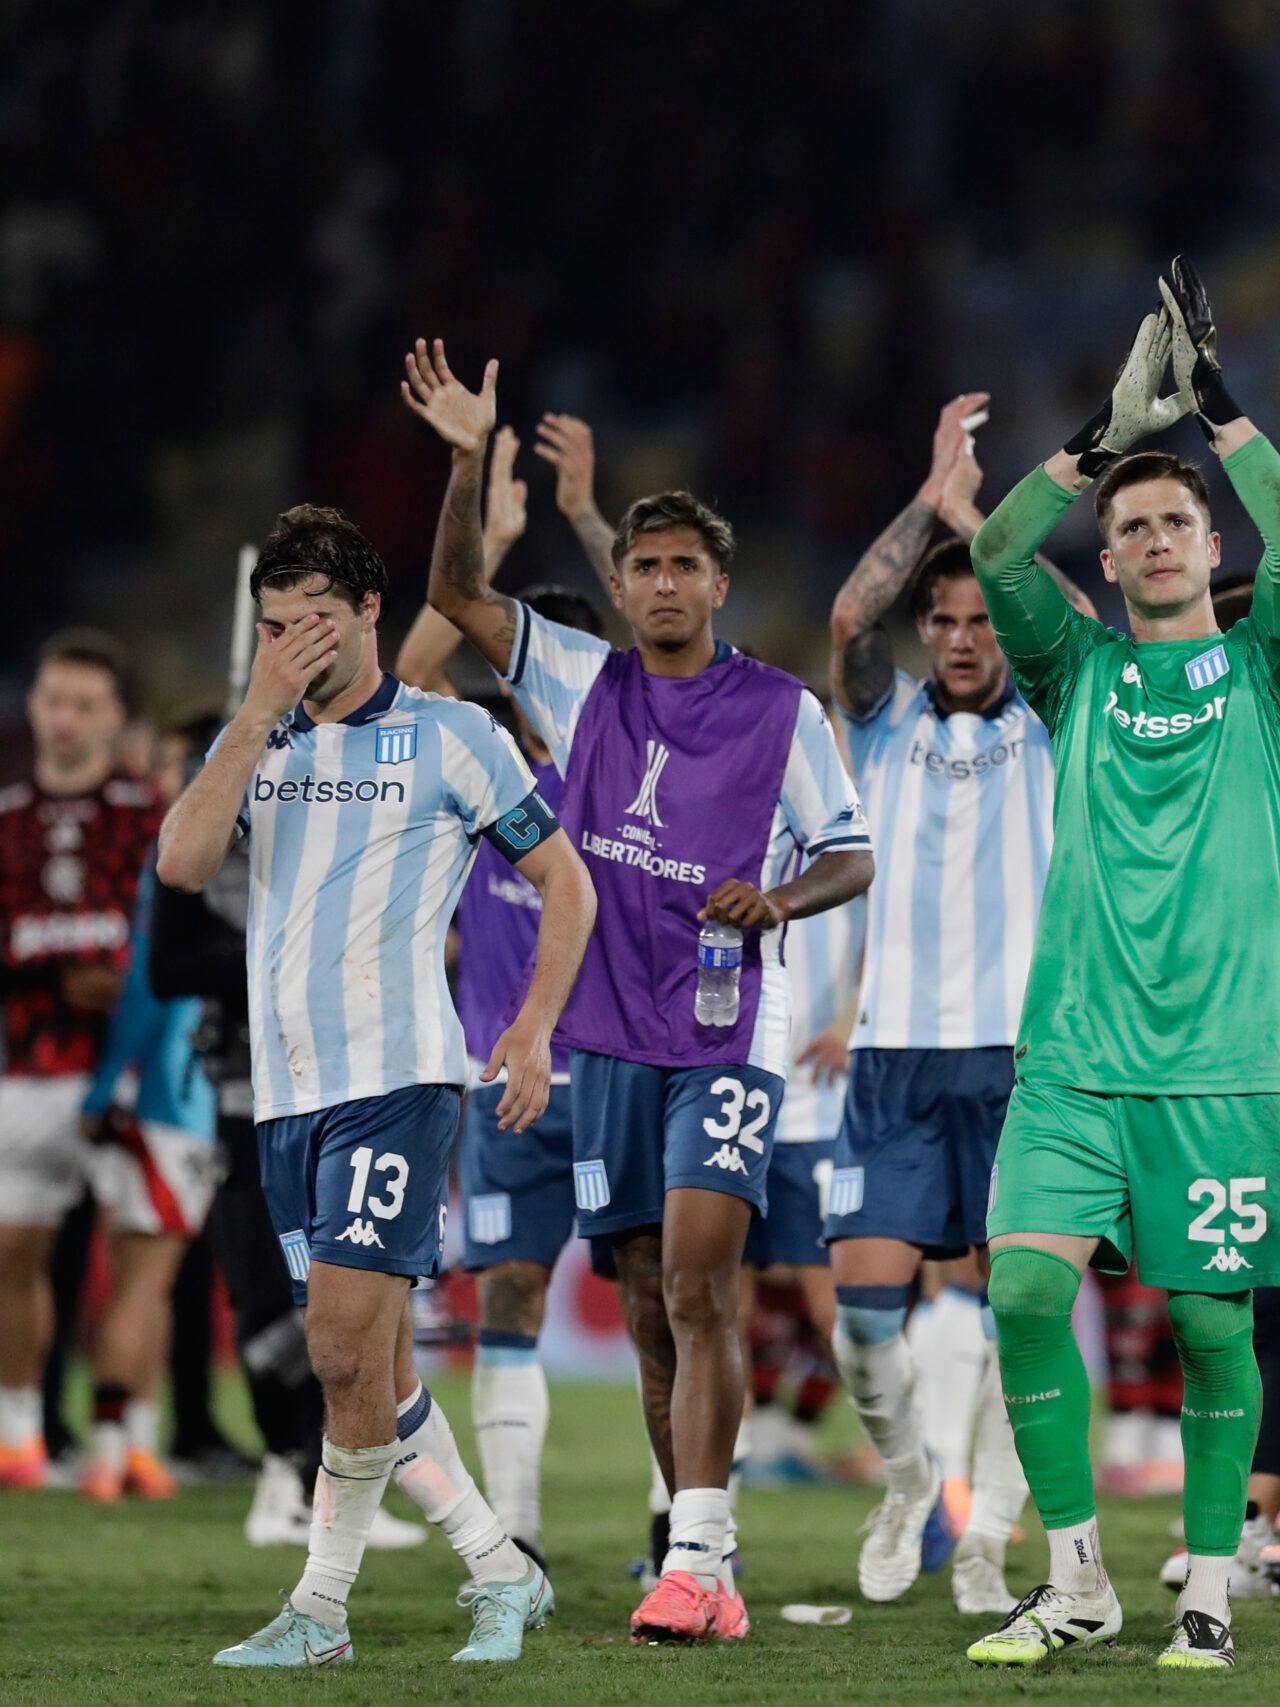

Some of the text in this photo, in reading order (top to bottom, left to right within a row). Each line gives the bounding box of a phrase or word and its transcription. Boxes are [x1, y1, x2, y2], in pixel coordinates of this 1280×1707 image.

[380, 727, 414, 736] RACING
[254, 774, 405, 803] betsson
[496, 808, 540, 850] C
[582, 830, 706, 884] LBERTAORES
[703, 1076, 771, 1154] 32
[347, 1146, 409, 1221] 13
[1188, 1177, 1267, 1243] 25
[1003, 1389, 1061, 1404] ACING
